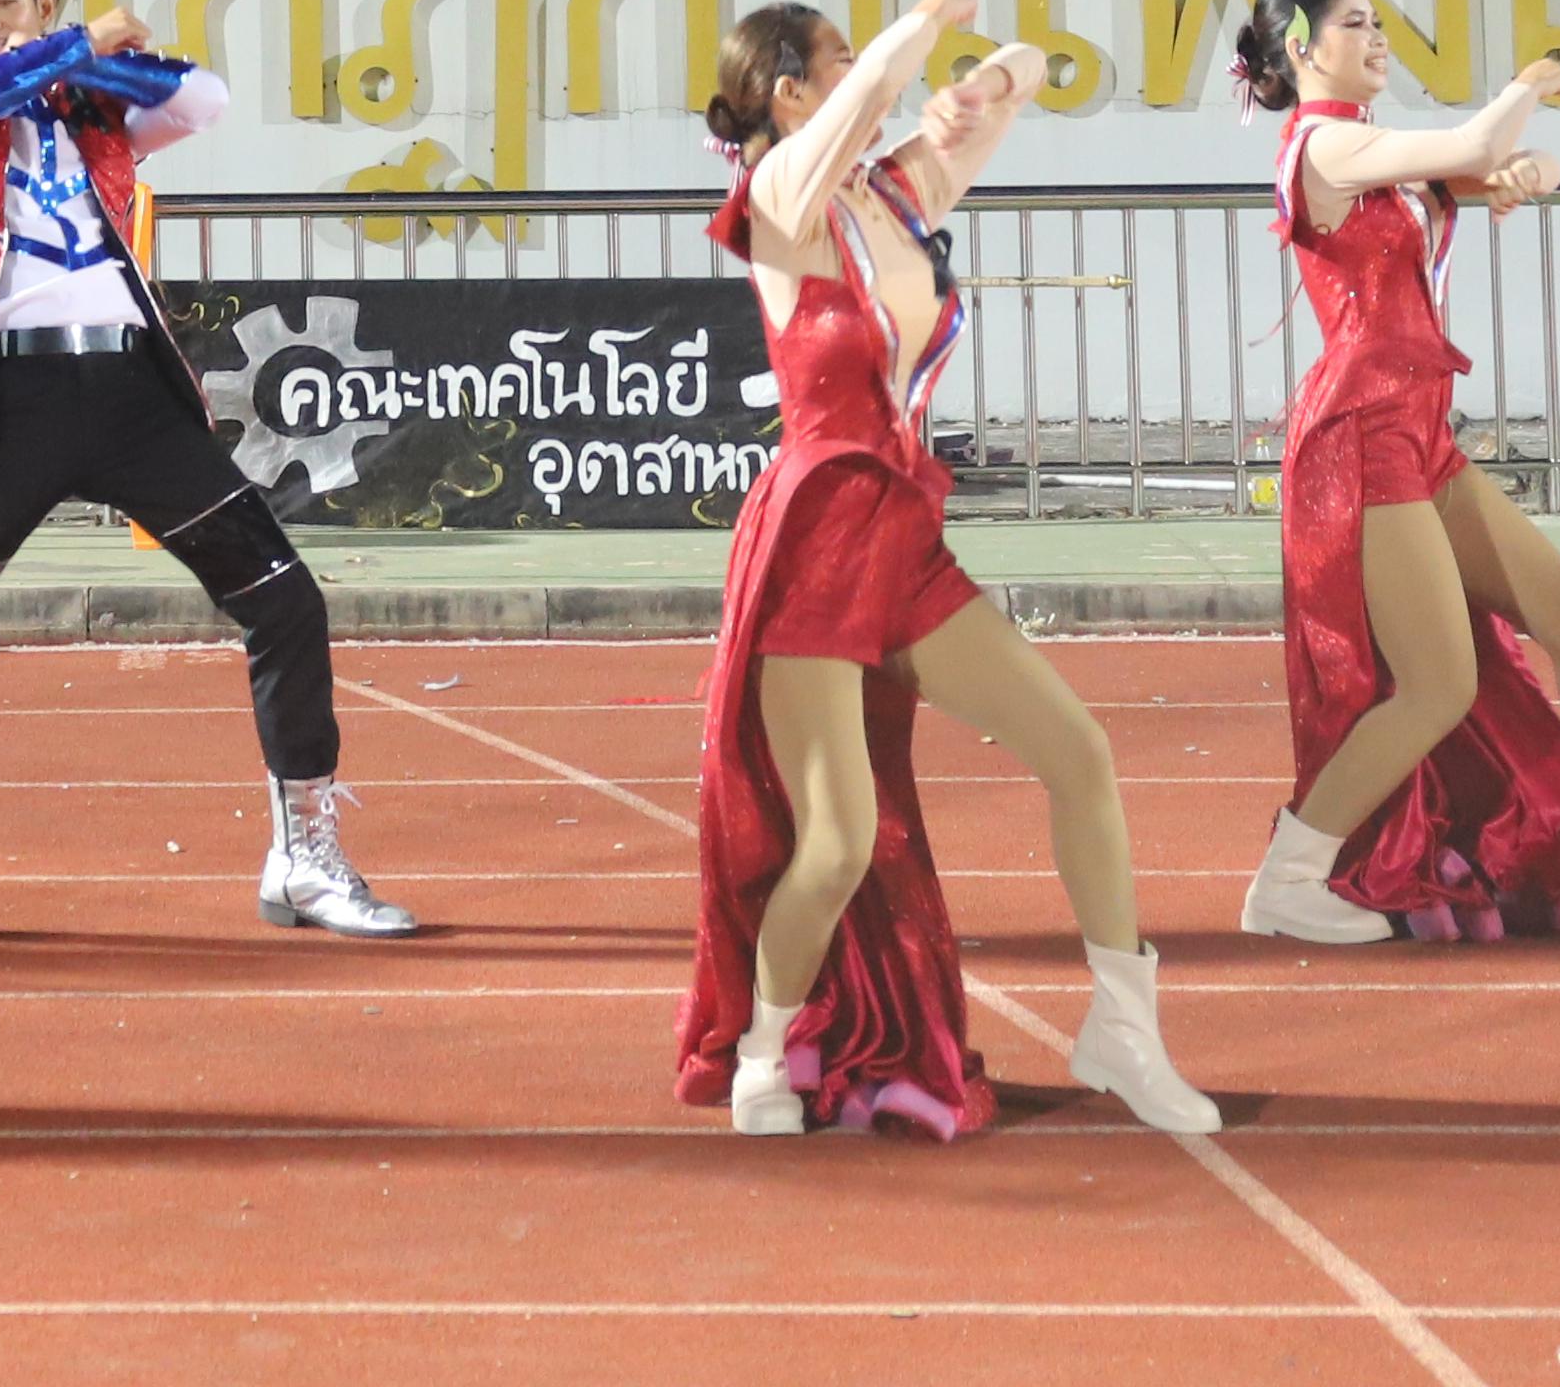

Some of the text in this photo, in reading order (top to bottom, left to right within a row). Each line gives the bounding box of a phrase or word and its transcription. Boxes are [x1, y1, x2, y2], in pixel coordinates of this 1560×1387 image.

[279, 326, 710, 427] คณะเทคโนโลยี
[528, 432, 782, 516] อุตสาหก
